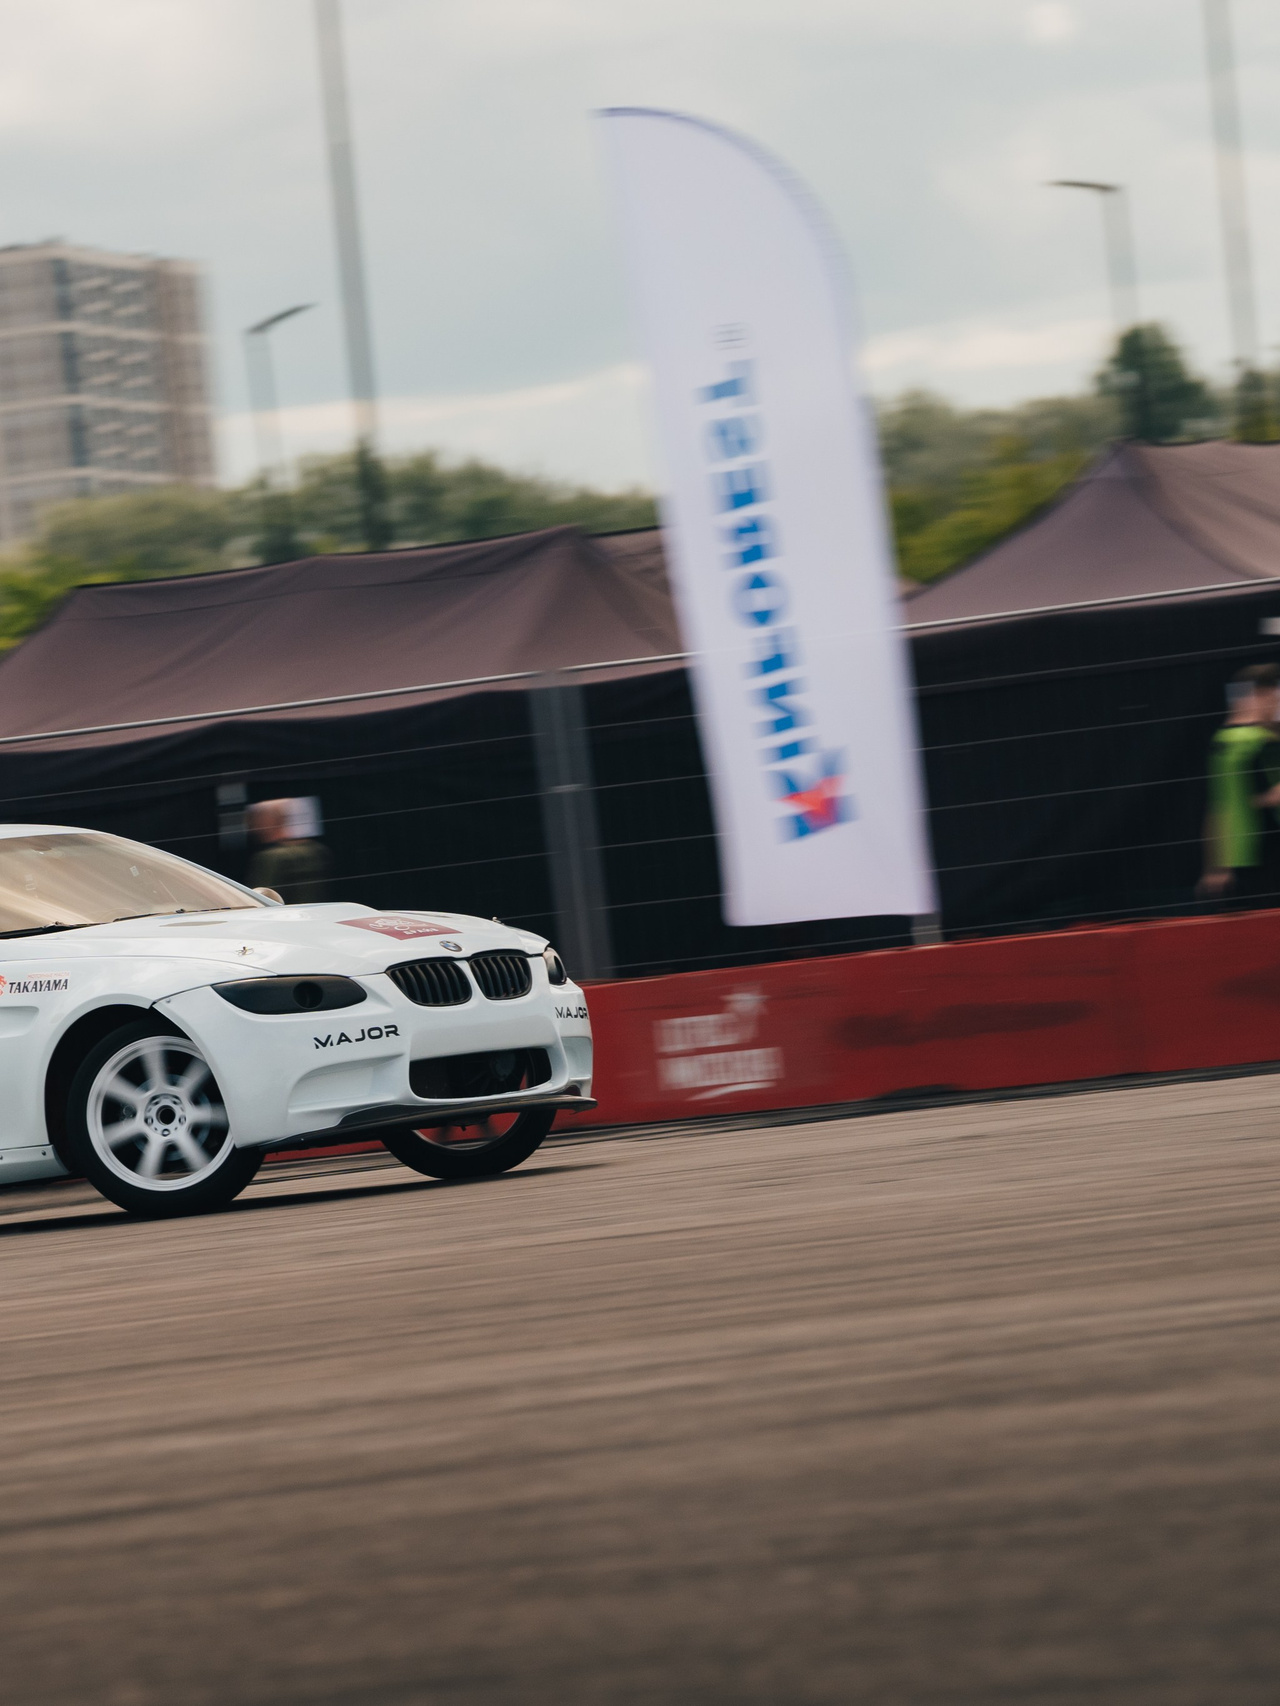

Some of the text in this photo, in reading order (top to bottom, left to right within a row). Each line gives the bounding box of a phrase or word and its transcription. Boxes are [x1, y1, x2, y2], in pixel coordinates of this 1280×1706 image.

[9, 978, 69, 994] TAKAYAMA
[554, 1006, 589, 1020] MAJOR
[313, 1024, 401, 1050] MAJOR
